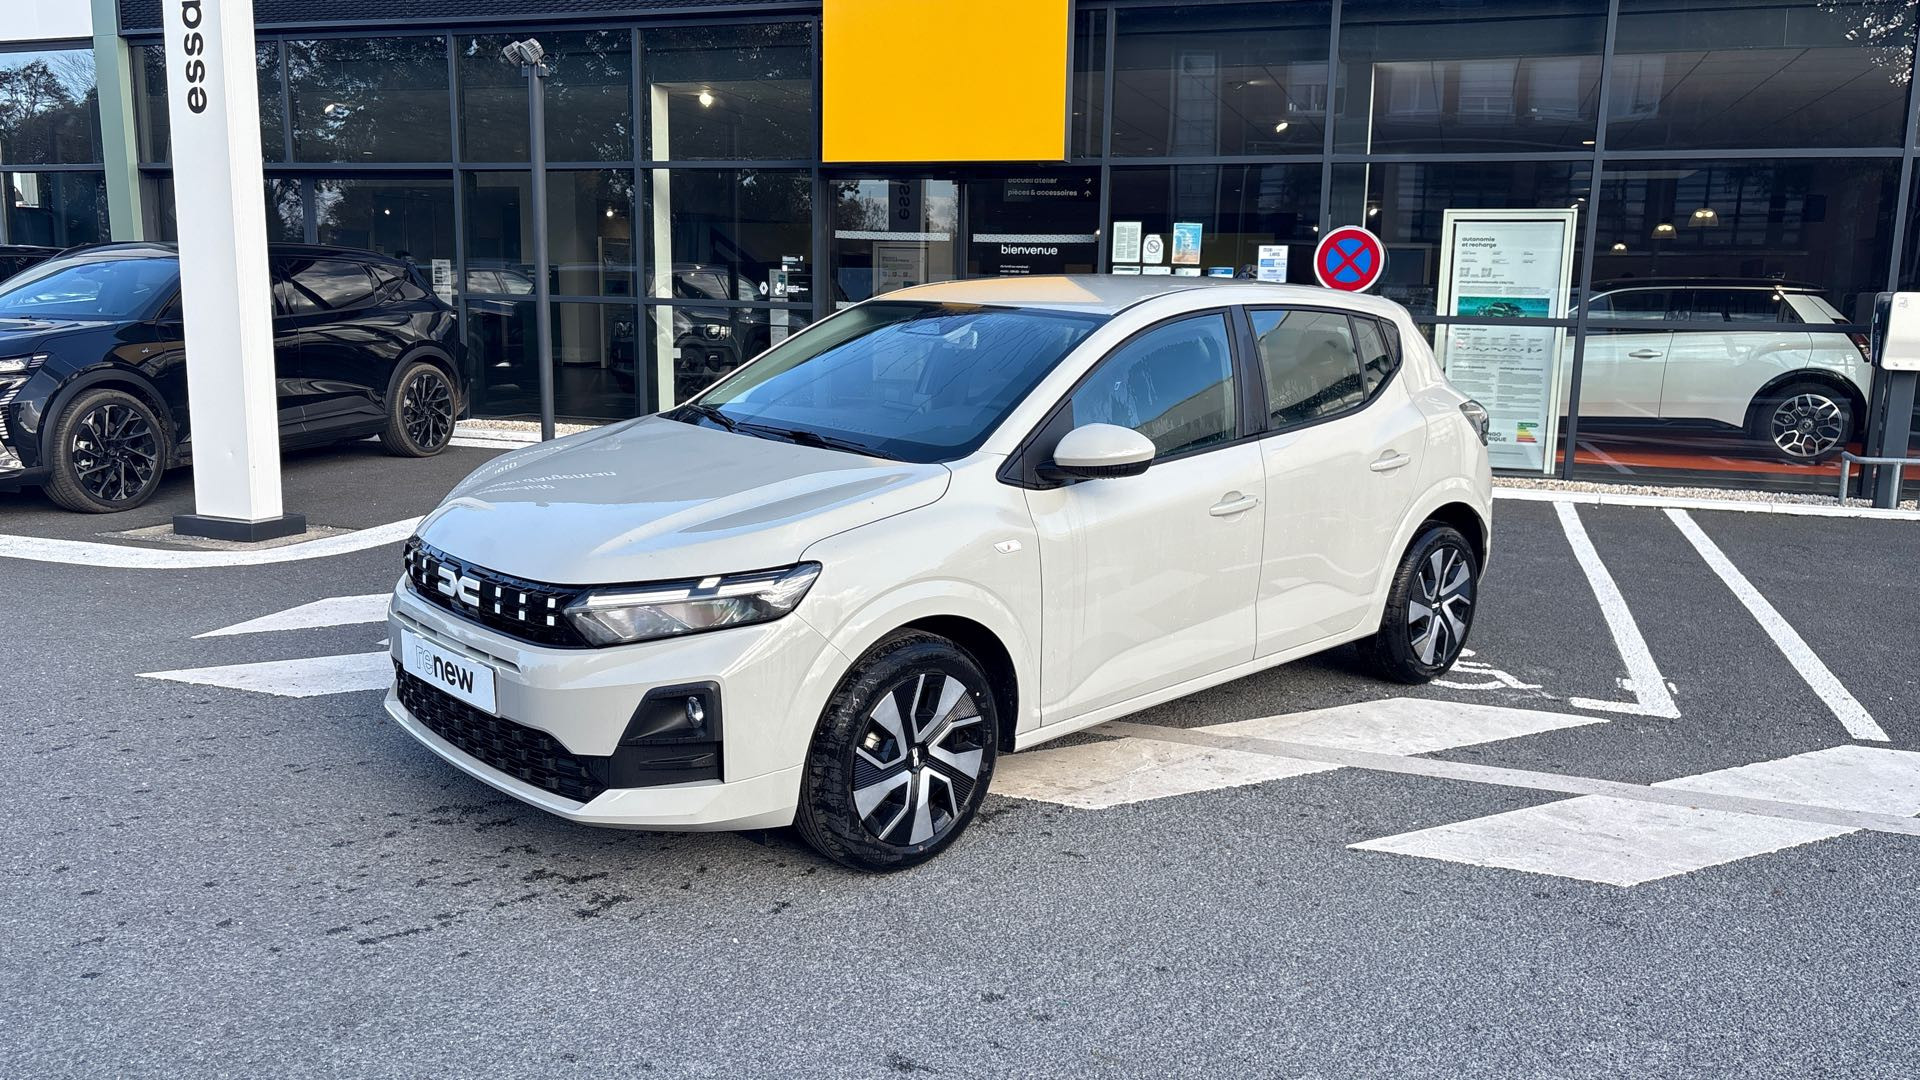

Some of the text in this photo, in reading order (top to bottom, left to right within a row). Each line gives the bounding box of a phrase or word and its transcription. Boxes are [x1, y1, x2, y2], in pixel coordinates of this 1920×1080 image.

[1008, 188, 1031, 197] pièces
[1036, 189, 1078, 197] accessoires
[1001, 244, 1058, 255] bienvenue
[415, 645, 474, 694] renew
